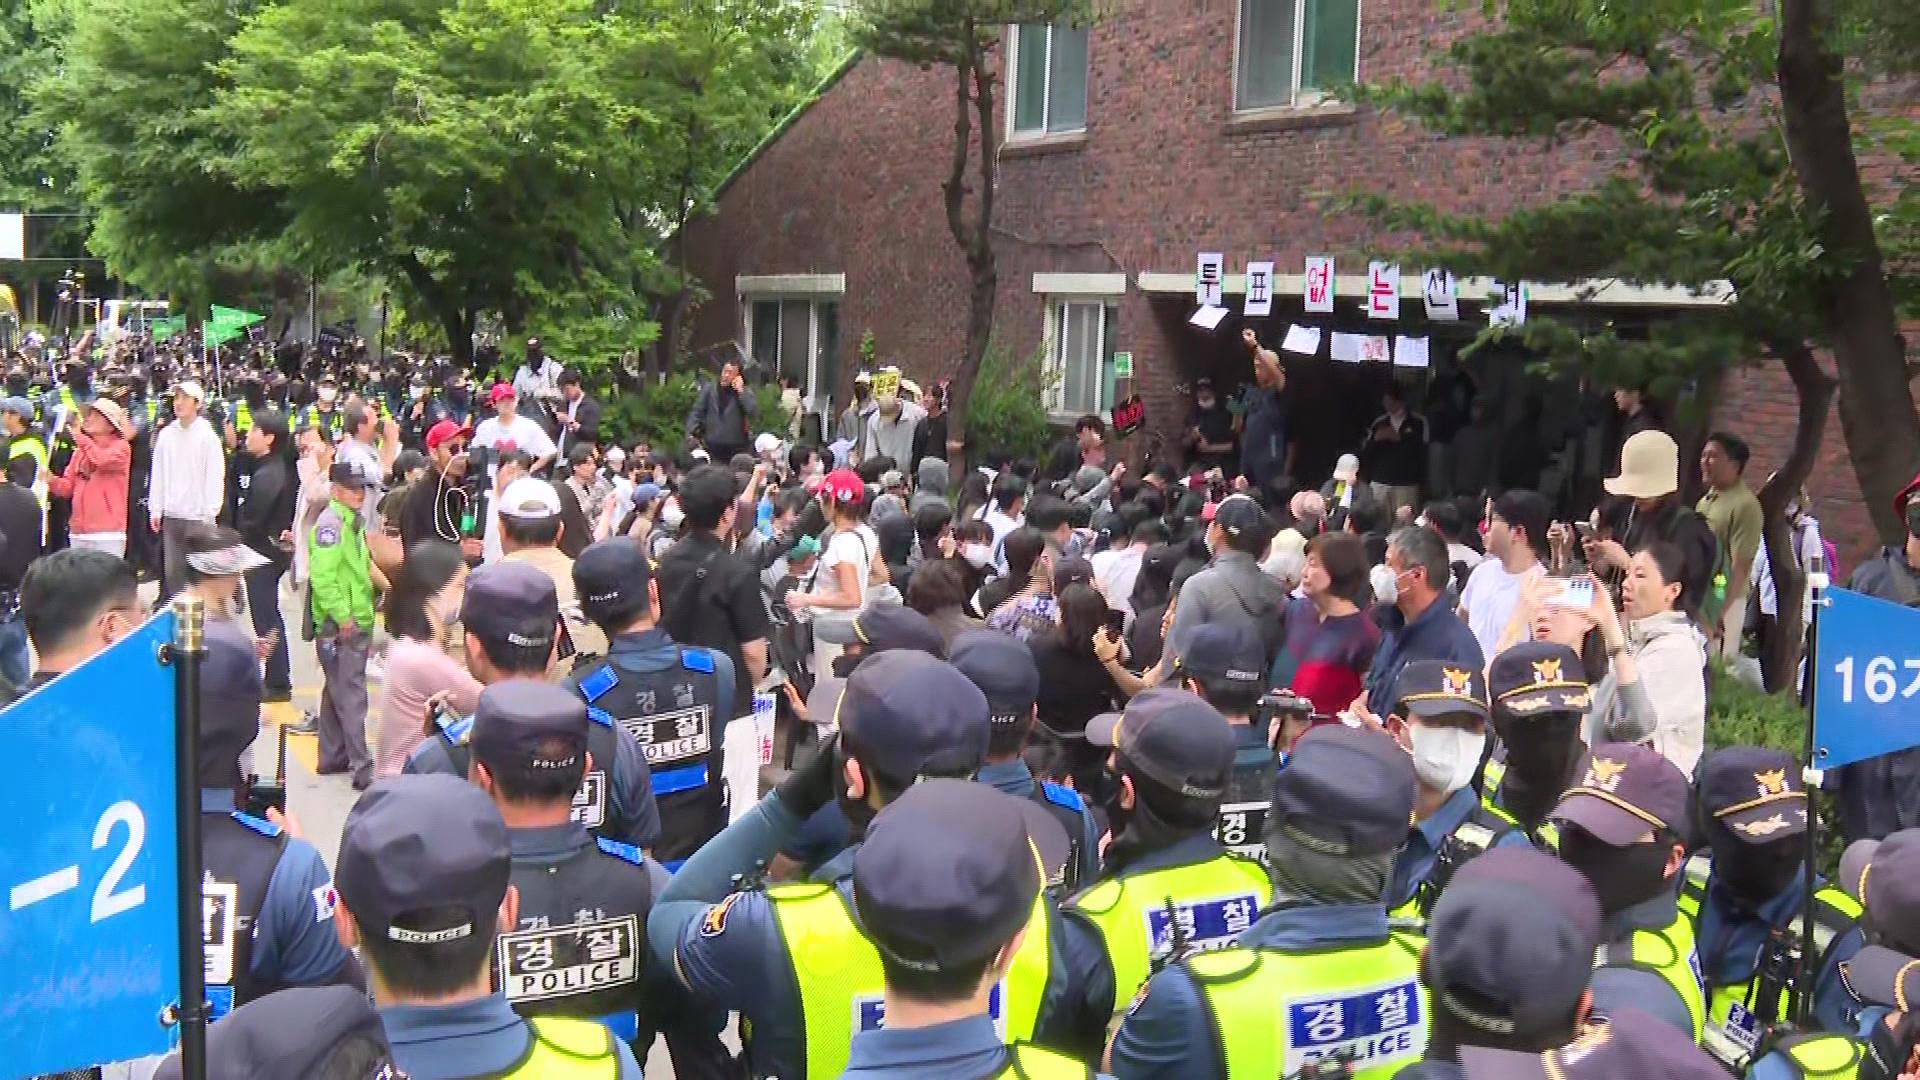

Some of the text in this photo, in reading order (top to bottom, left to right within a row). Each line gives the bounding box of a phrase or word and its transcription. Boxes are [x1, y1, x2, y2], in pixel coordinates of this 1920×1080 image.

[991, 715, 1016, 723] LICE
[643, 738, 698, 760] OLICE
[532, 755, 576, 769] POLICE
[398, 927, 462, 942] POLICE
[516, 929, 623, 971] 경찰
[522, 961, 620, 993] POLICE
[1301, 987, 1409, 1041] 경찰
